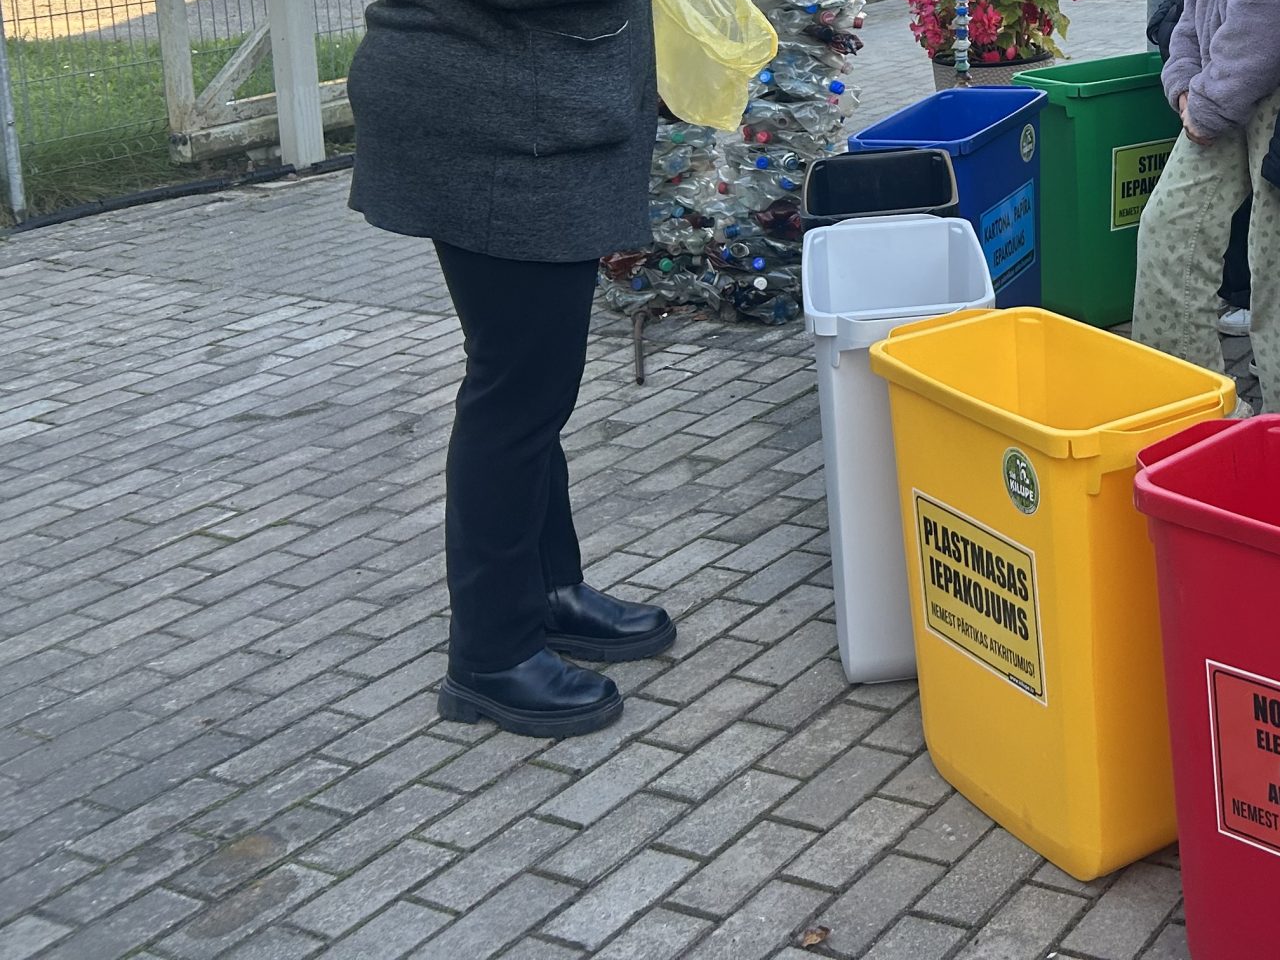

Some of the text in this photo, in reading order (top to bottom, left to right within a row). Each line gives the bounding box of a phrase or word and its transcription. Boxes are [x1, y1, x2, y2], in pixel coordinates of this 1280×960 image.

[1139, 151, 1171, 173] STIK
[993, 229, 1025, 269] IEPAKOJUMS
[923, 515, 1029, 602] PLASTMASAS
[929, 556, 1029, 641] IEPAKOJUMS
[931, 601, 1035, 679] NEMEST PĀRTIKAS ATKRITUMUS!
[1232, 798, 1278, 832] NEMEST
